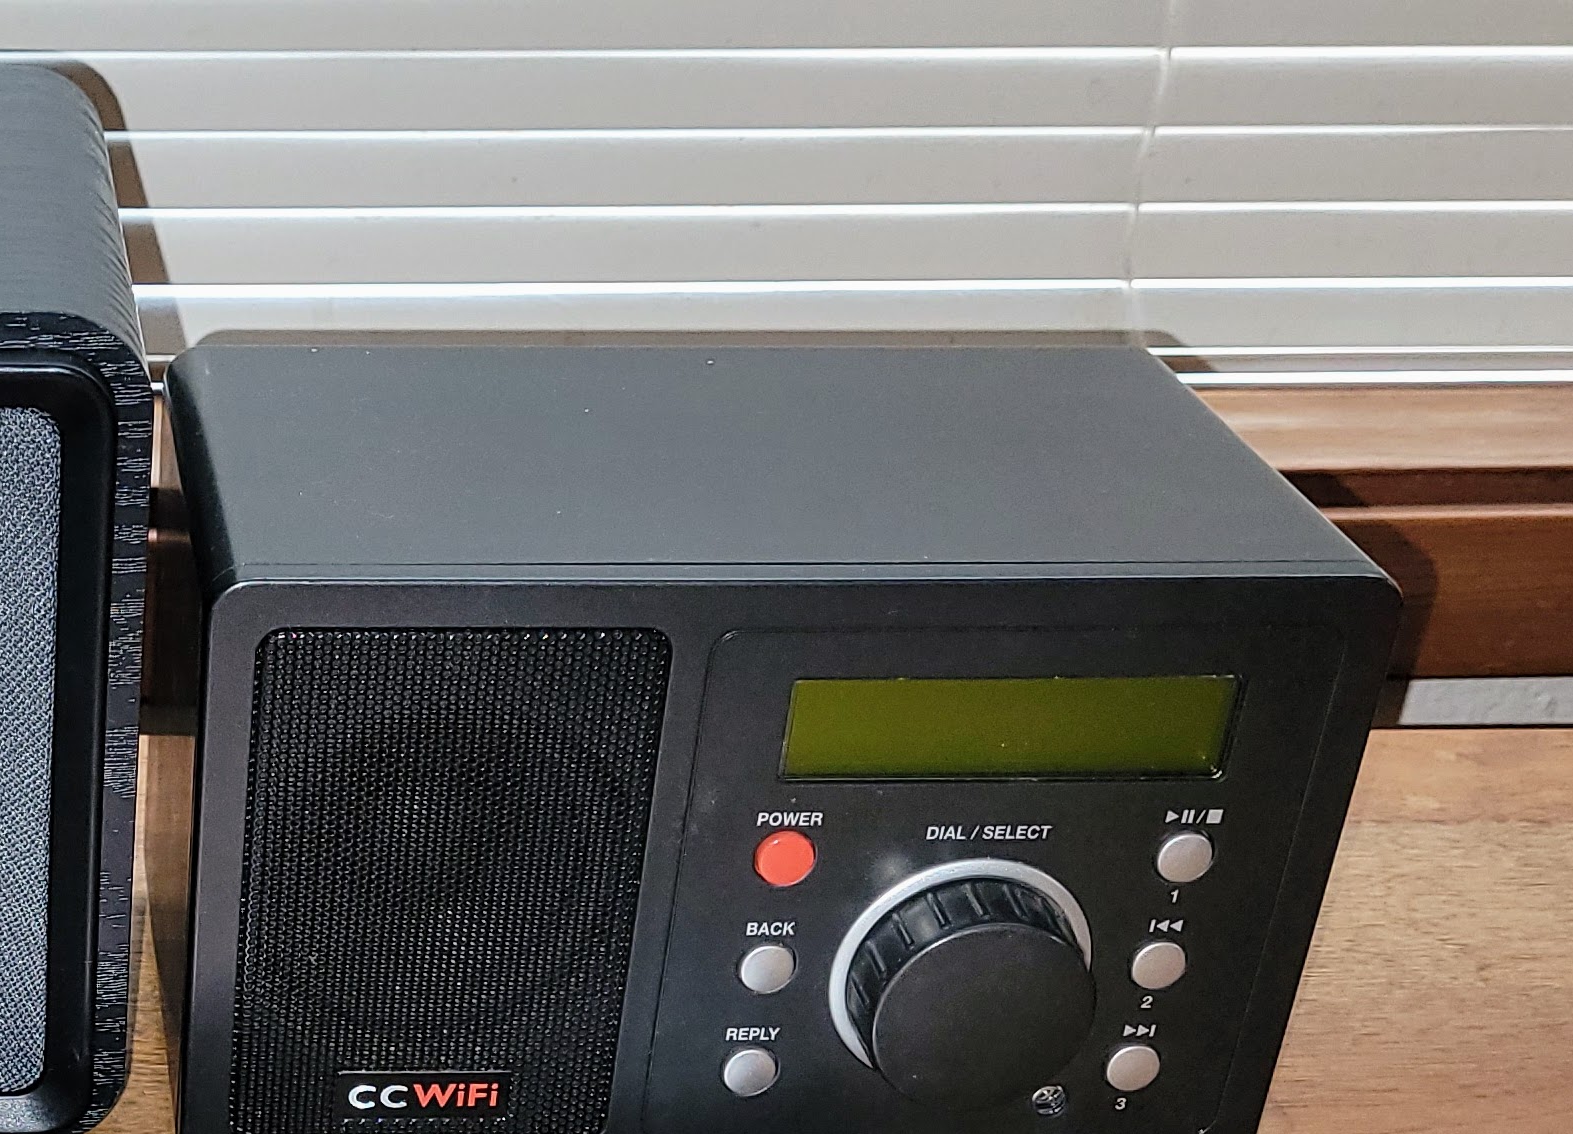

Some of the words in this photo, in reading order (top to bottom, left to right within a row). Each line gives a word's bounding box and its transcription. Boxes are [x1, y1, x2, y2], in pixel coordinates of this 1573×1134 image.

[756, 811, 824, 827] POWER
[926, 825, 966, 840] DIAL
[982, 825, 1052, 840] SELECT
[1170, 891, 1180, 904] 1
[746, 921, 795, 936] BACK
[1140, 996, 1154, 1009] 2
[725, 1027, 780, 1042] REPLY
[1115, 1097, 1127, 1110] 3
